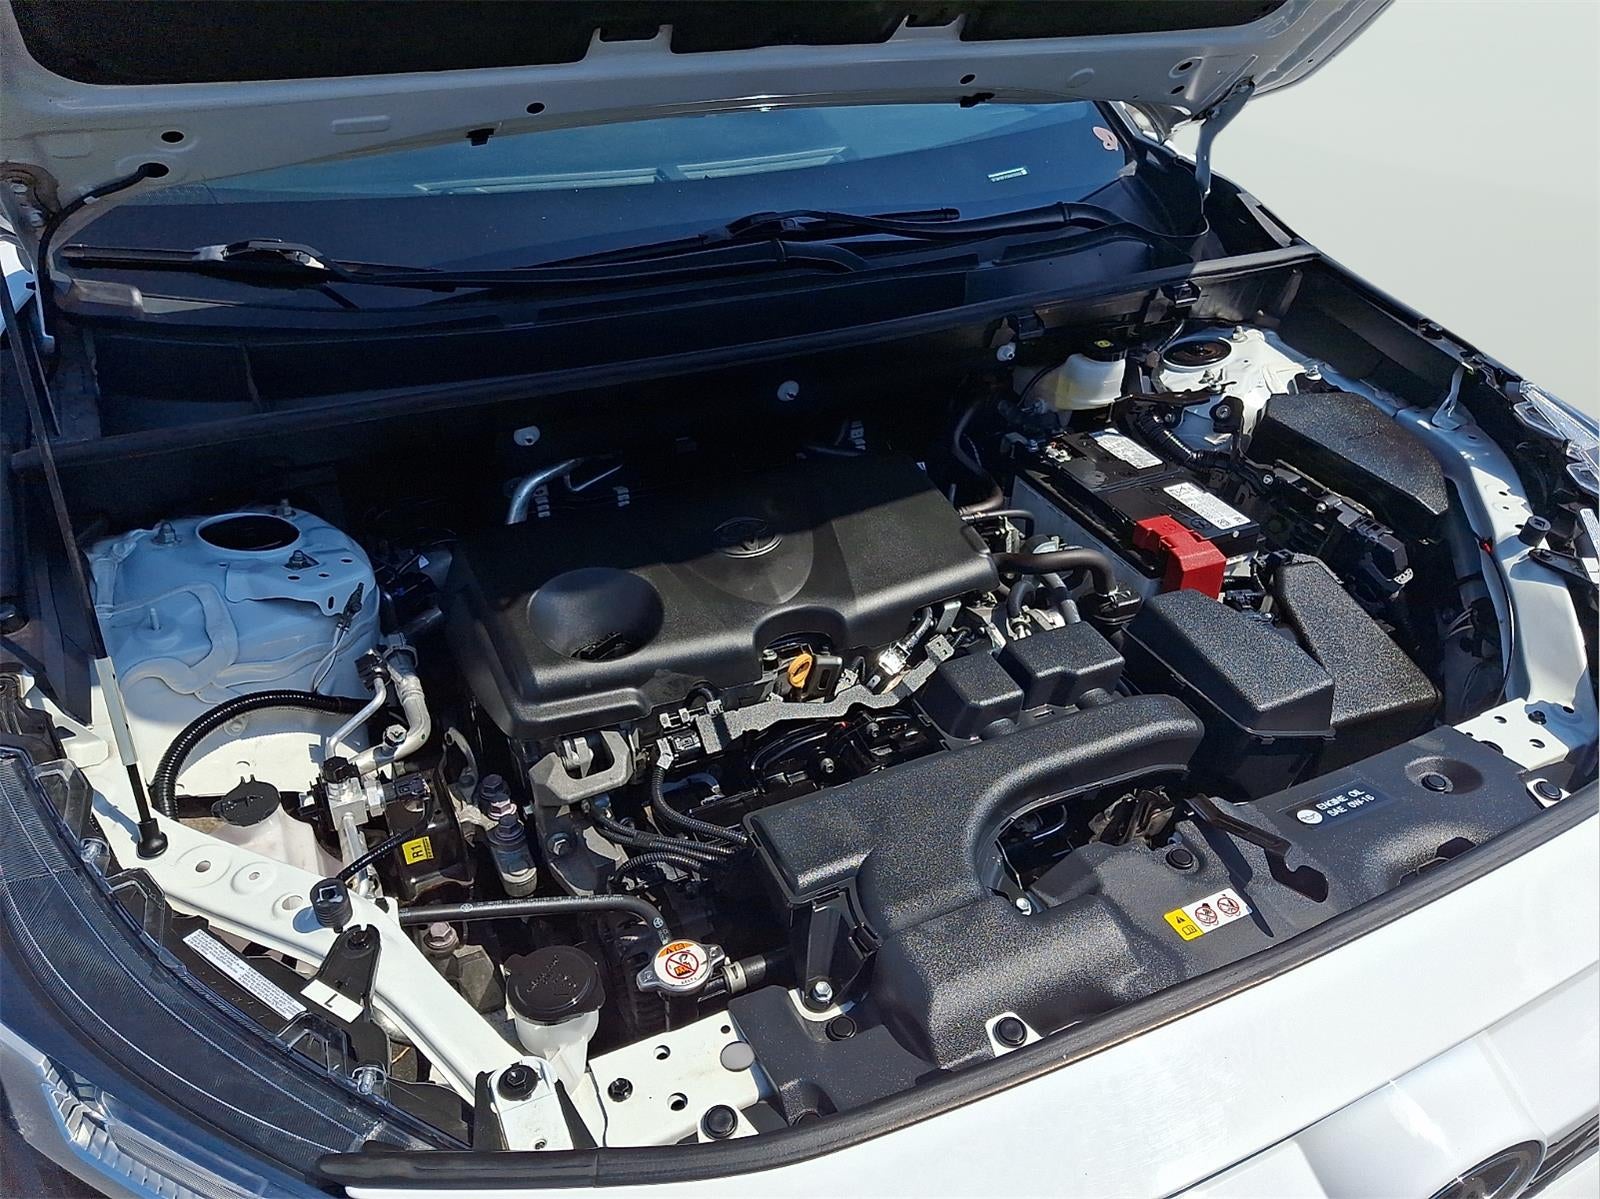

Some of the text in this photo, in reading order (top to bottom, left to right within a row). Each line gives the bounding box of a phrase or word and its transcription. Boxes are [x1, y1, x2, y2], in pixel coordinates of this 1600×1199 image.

[1316, 789, 1365, 810] ENGINE OIL
[1326, 794, 1375, 816] SAE 0W-16
[411, 844, 424, 858] R1
[324, 993, 338, 1008] L
